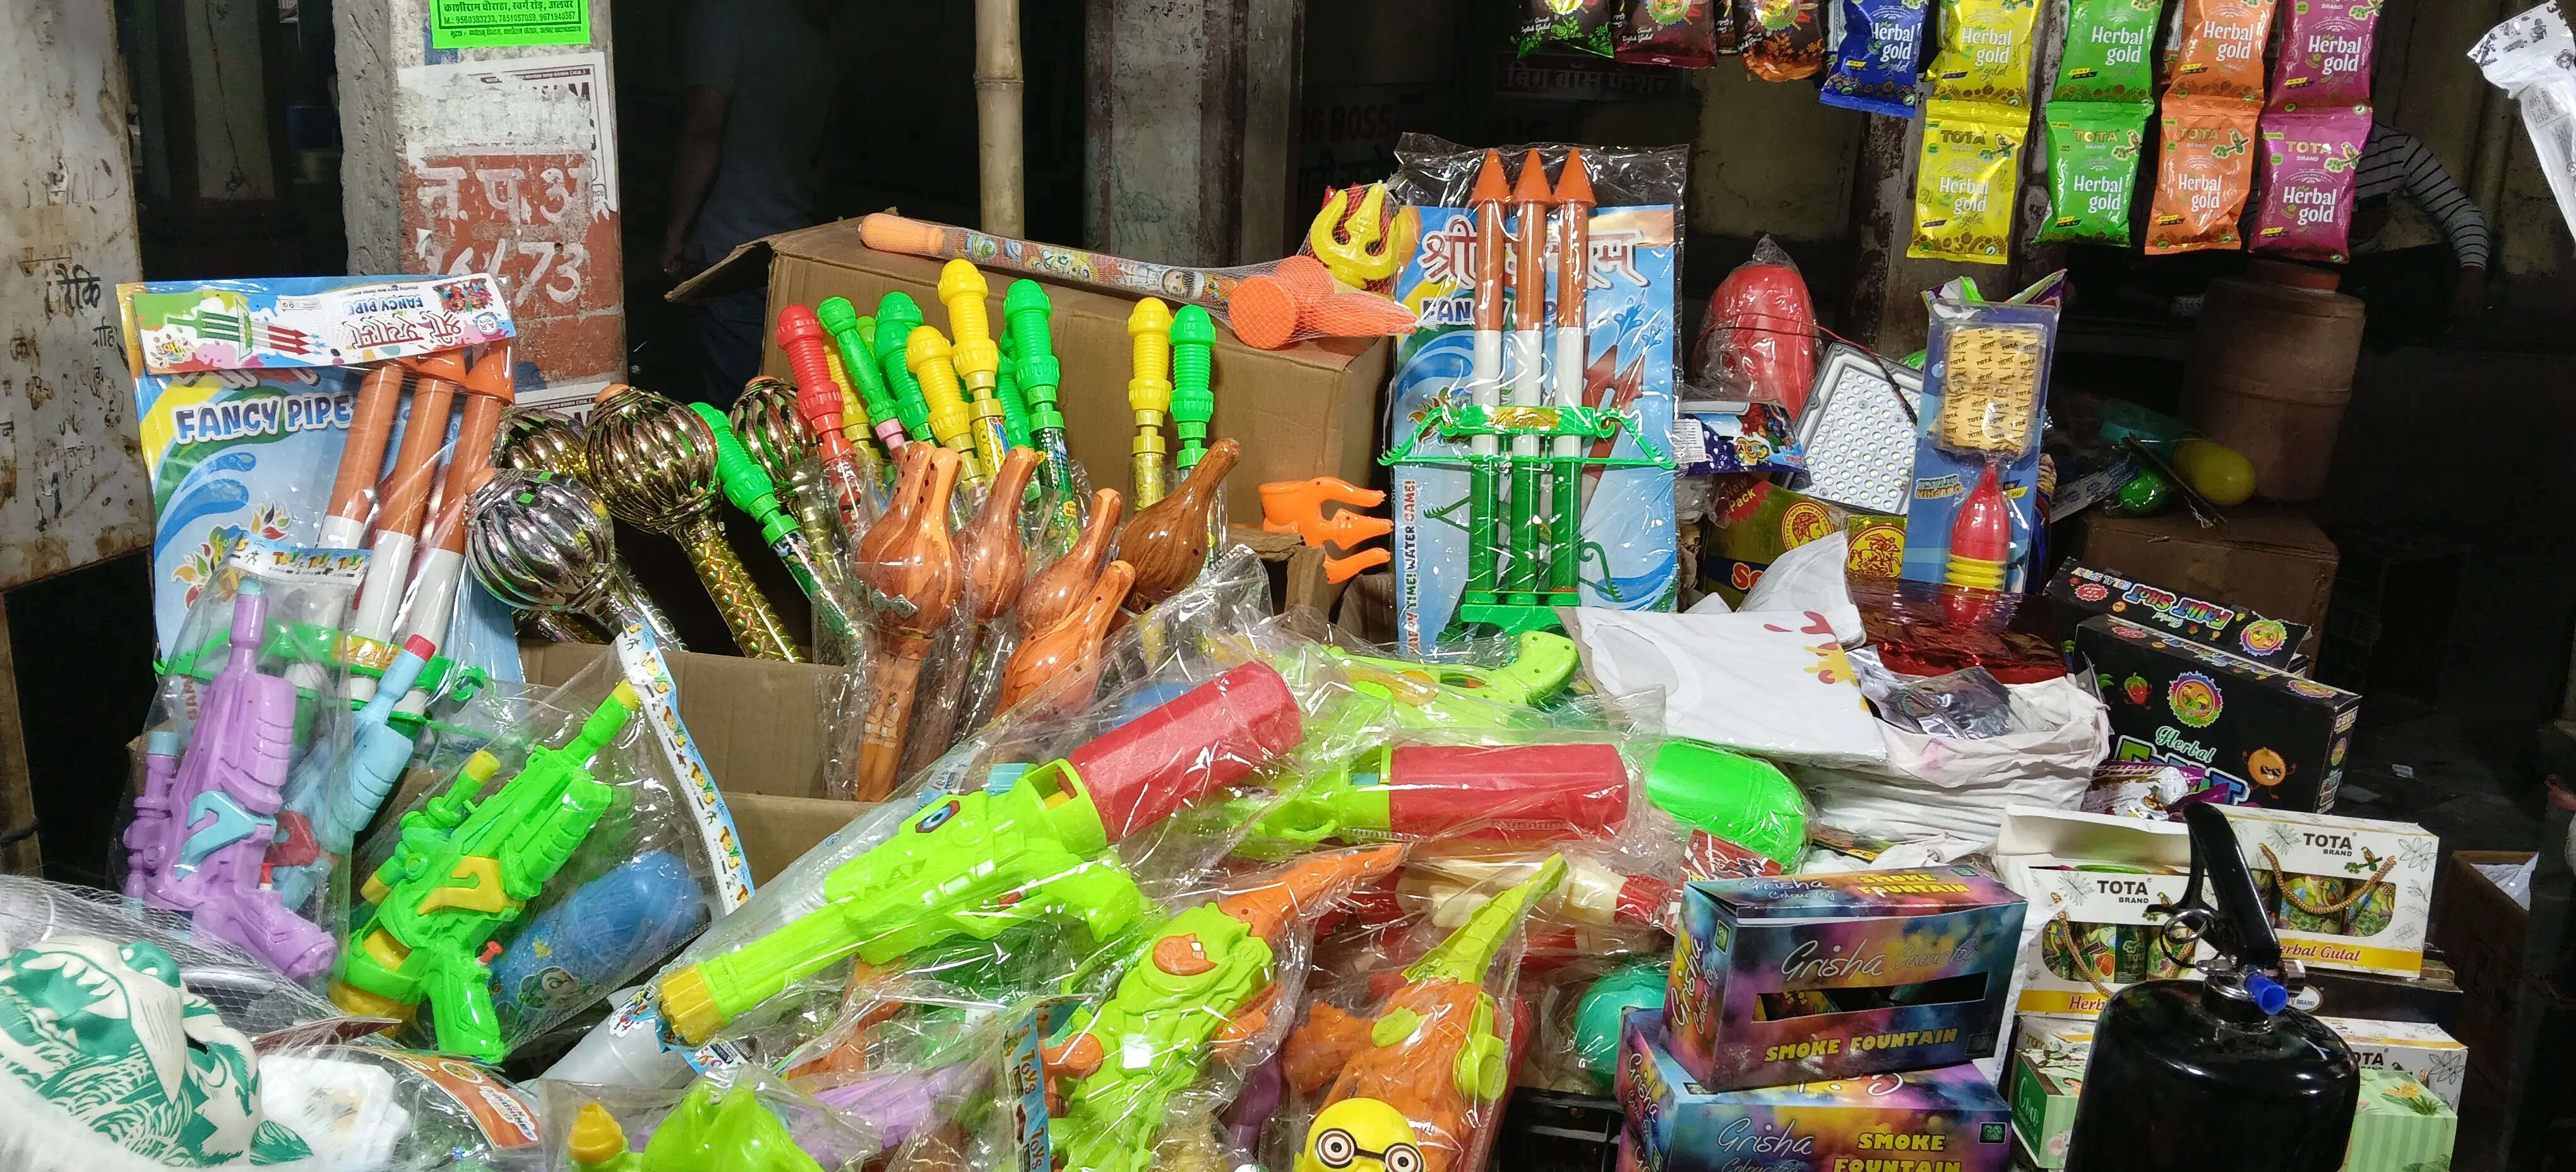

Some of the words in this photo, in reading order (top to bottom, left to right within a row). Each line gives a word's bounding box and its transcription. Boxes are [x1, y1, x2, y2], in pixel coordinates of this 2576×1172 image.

[1870, 23, 1914, 42] Herbal
[1962, 27, 2012, 46] Herbal
[2092, 26, 2144, 45] Herbal
[2203, 20, 2254, 41] Herbal
[1880, 42, 1912, 62] gold
[2215, 41, 2251, 62] gold
[2308, 35, 2362, 54] Herbal
[1975, 47, 2010, 66] gold
[2105, 45, 2141, 66] gold
[2322, 54, 2359, 75] gold
[1332, 105, 1395, 140] BOSS
[1941, 130, 1986, 145] TOTA
[2073, 130, 2120, 143] TOTA
[2179, 128, 2219, 141] TOTA
[2286, 141, 2332, 154] TOTA
[1940, 176, 1989, 196] Herbal
[2073, 175, 2123, 193] Herbal
[2178, 174, 2222, 192] Herbal
[1953, 195, 1987, 215] gold
[2088, 193, 2121, 213] gold
[2191, 190, 2220, 212] gold
[2283, 186, 2337, 205] Herbal
[2298, 205, 2335, 225] gold
[1422, 216, 1476, 285] श्री
[379, 295, 423, 312] FANCY
[176, 399, 278, 442] FANCY
[287, 393, 351, 427] PIPE
[1726, 477, 1748, 496] New
[1403, 480, 1417, 523] GAME!
[1729, 487, 1756, 513] Pack
[1402, 526, 1417, 571] WATER
[1404, 572, 1417, 611] TIME!
[2125, 584, 2175, 611] SHOT
[2171, 598, 2233, 628] FRUIT
[2155, 726, 2217, 763] Herbal
[663, 705, 687, 748] TOYS
[691, 761, 717, 806] TOYS
[719, 825, 741, 870] TOYS
[2303, 833, 2352, 850] TOTA
[2323, 849, 2352, 857] BRAND
[1738, 877, 1831, 892] Grisha
[1858, 873, 1937, 883] SMOKE
[2097, 880, 2148, 895] TOTA
[1862, 883, 1970, 895] FOUNTAIN
[1780, 938, 1885, 981] Grisha
[2280, 943, 2317, 957] erbal
[2320, 946, 2361, 962] Gulal
[1671, 933, 1703, 1026] Grisha
[2069, 995, 2106, 1011] Herb
[1764, 1038, 1841, 1063] SMOKE
[1849, 1027, 1959, 1053] FOUNTAIN
[2352, 1051, 2384, 1066] OTA
[1717, 1118, 1814, 1155] Grisha
[1857, 1133, 1947, 1152] SMOKE
[1834, 1159, 1960, 1172] FOUNTAIN
